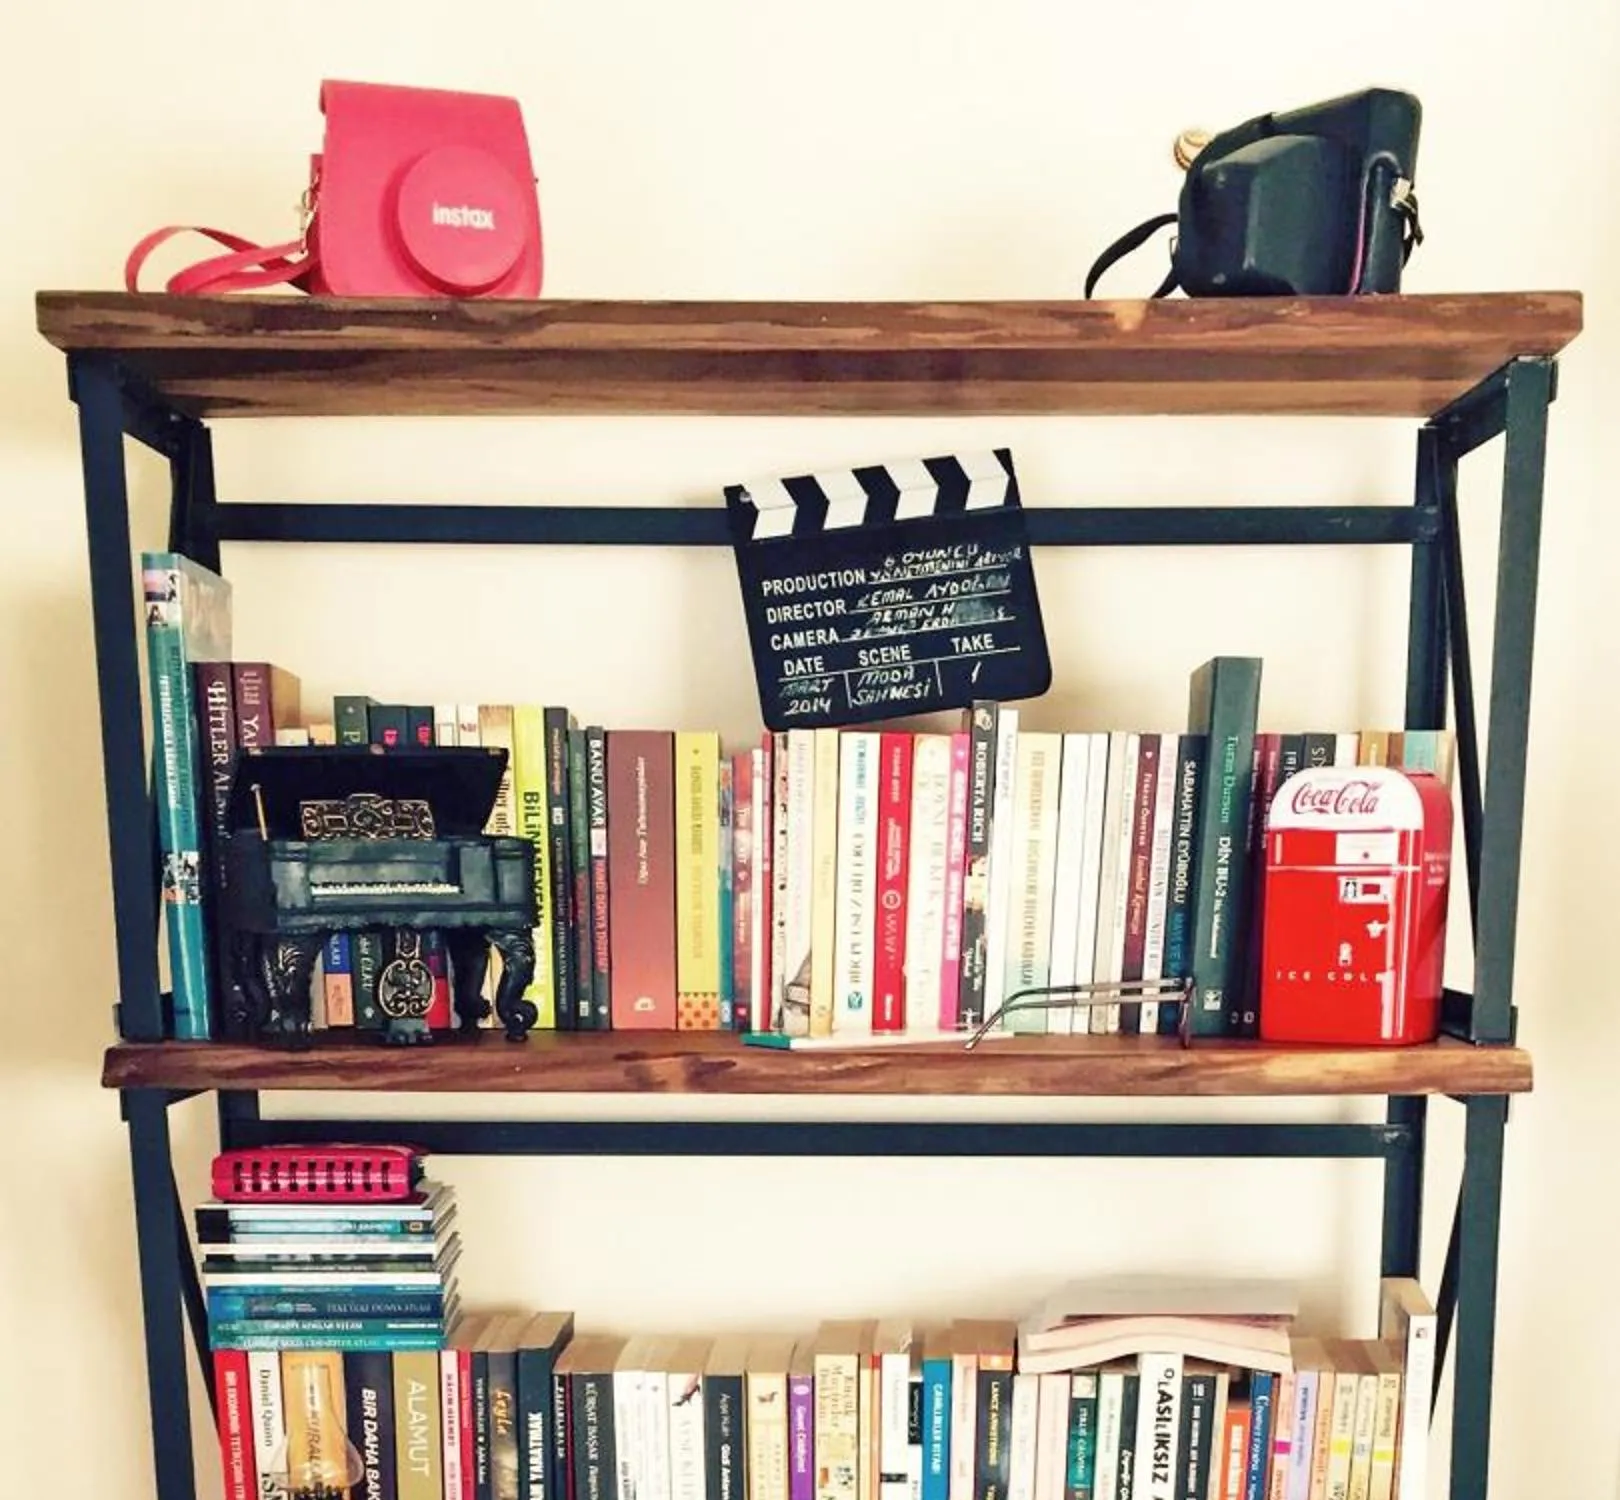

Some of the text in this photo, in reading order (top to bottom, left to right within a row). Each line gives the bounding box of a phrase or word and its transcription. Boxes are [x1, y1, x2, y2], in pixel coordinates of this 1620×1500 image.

[432, 200, 496, 231] instax
[762, 569, 866, 597] PRODUCTION
[766, 600, 847, 624] DIRECTOR
[771, 628, 840, 651] CAMERA
[783, 633, 995, 677] DATE SCENE TAKE
[784, 698, 832, 717] 2014
[1225, 735, 1239, 773] Turan
[590, 739, 603, 828] BANU AVAR
[971, 741, 988, 843] ROBERTA RICH
[1220, 775, 1236, 824] Dursun
[1215, 836, 1232, 864] DİN
[1173, 840, 1193, 904] EYÜBOĞLU
[1276, 971, 1312, 982] ICE
[259, 1368, 275, 1447] Daniel Quinn
[989, 1381, 1000, 1410] LANCE
[365, 1419, 380, 1464] DAHA
[406, 1380, 430, 1477] ALAMUT
